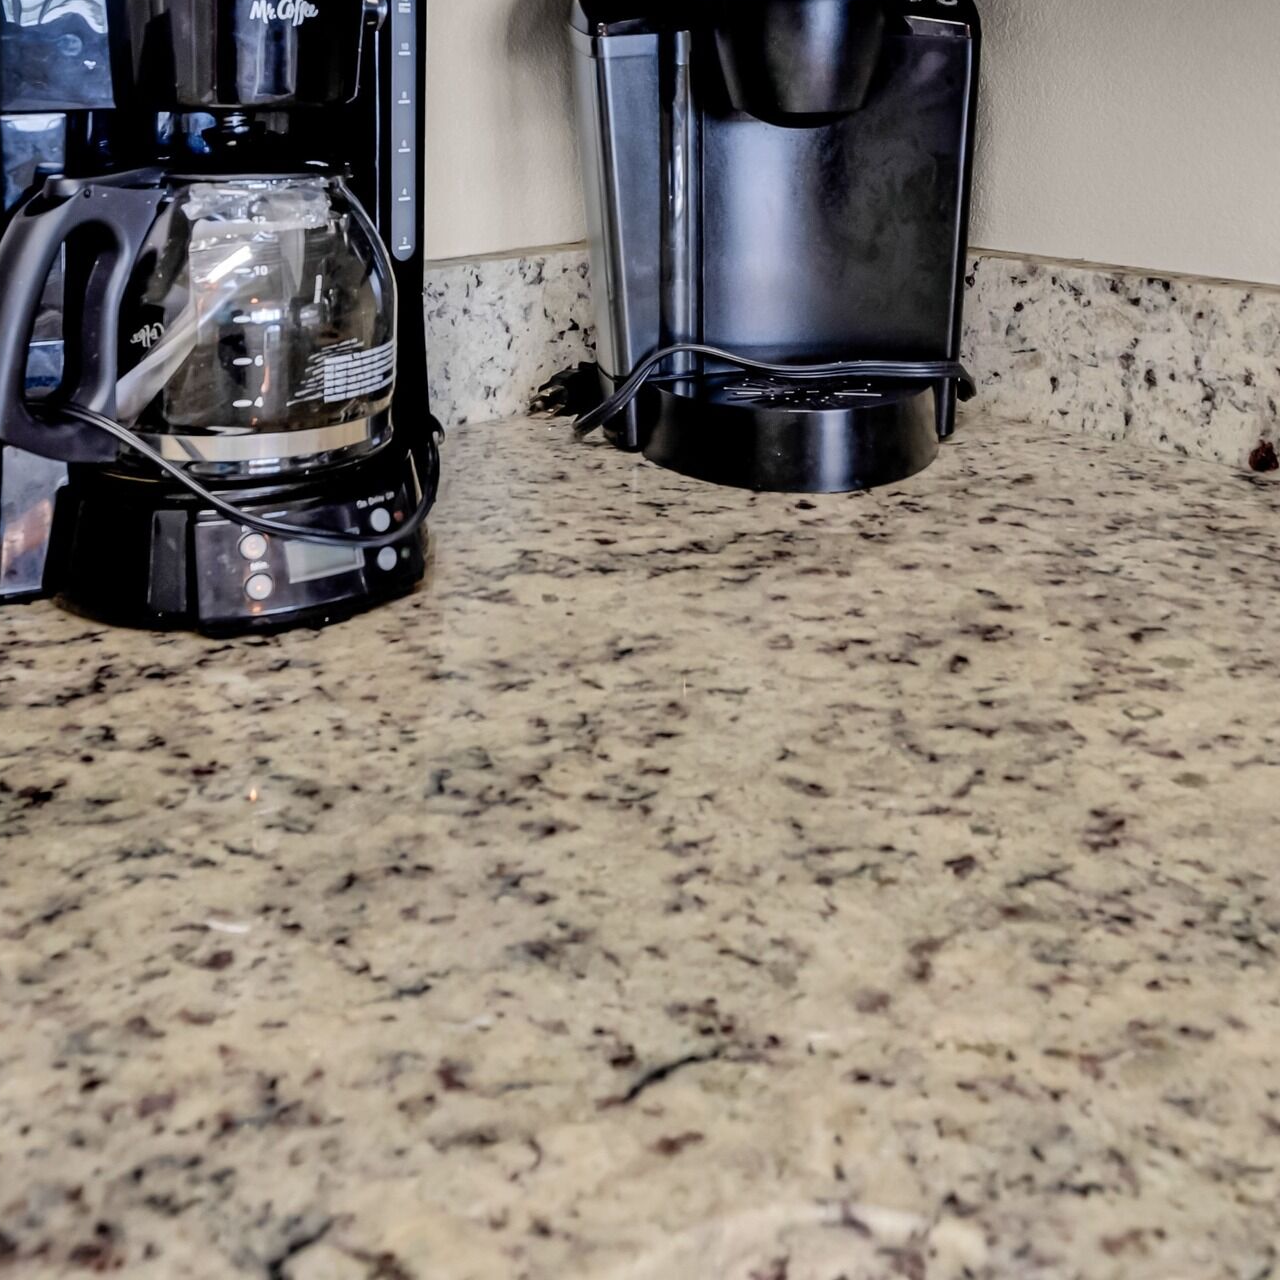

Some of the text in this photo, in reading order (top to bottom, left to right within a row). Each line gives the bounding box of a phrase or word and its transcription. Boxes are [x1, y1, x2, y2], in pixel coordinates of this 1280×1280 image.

[253, 266, 268, 276] 10
[254, 354, 264, 367] 6
[253, 396, 264, 408] 4
